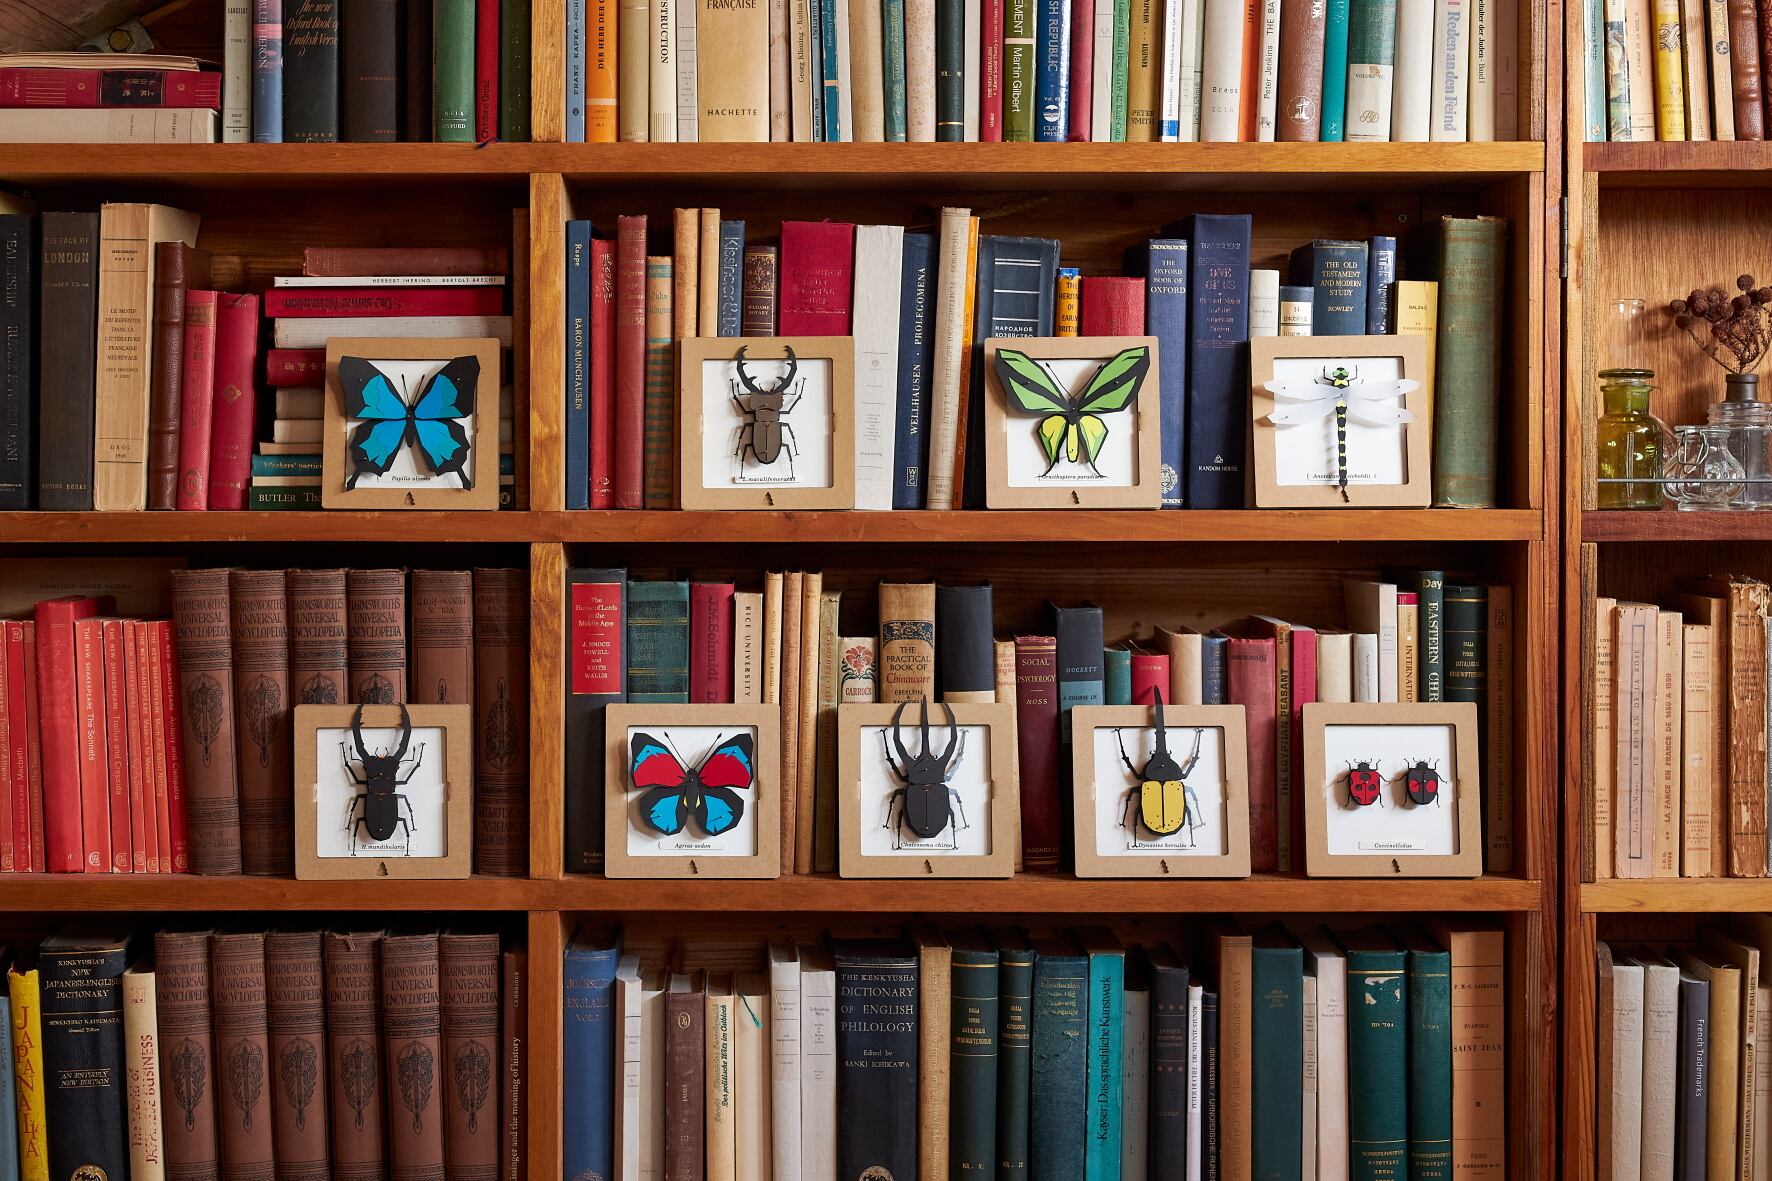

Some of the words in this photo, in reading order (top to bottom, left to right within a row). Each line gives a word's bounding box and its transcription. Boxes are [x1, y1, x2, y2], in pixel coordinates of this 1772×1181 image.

[706, 0, 757, 12] FRANÇAISE
[287, 17, 311, 31] Oxford
[312, 18, 330, 29] Book
[1266, 18, 1274, 35] THE
[1447, 11, 1461, 51] Reden
[1478, 24, 1486, 36] der
[597, 26, 605, 49] HERR
[1048, 18, 1059, 72] REPUBLIC
[258, 29, 268, 68] HERON
[797, 32, 805, 60] Klinzing
[1478, 37, 1486, 59] Juden
[1012, 47, 1023, 79] Martin
[1265, 45, 1273, 76] Jenkins
[1478, 63, 1486, 80] Band
[1263, 78, 1272, 99] Peter
[1445, 71, 1459, 94] den
[1012, 80, 1022, 113] Gilbert
[707, 108, 757, 116] HACHETTE
[1132, 109, 1155, 117] PETER
[1444, 96, 1458, 131] Feind
[1114, 104, 1123, 140] Klett-Cotta
[1131, 117, 1155, 125] SMITH
[44, 252, 89, 264] LONDON
[573, 243, 582, 267] Raspe
[723, 237, 740, 301] Kissinger
[1324, 261, 1340, 269] THE
[1343, 261, 1358, 269] OLD
[1322, 270, 1360, 278] TESTAMENT
[1150, 286, 1186, 294] OXFORD
[1320, 279, 1335, 287] AND
[1335, 279, 1362, 287] MODERN
[914, 267, 926, 345] PROLEGOMENA
[575, 317, 583, 348] BARON
[575, 349, 583, 410] MUNCHAUSEN
[910, 364, 921, 435] WELLHAUSEN
[66, 483, 87, 491] BOOKS
[258, 494, 296, 502] BUTLER
[303, 492, 322, 502] The
[1423, 578, 1442, 590] Day
[180, 611, 224, 624] UNIVERSAL
[239, 612, 282, 624] UNIVERSAL
[296, 612, 340, 623] UNIVERSAL
[354, 612, 396, 624] UNIVERSAL
[1428, 601, 1439, 664] EASTERN
[899, 646, 916, 654] THE
[886, 655, 930, 663] PRACTICAL
[1022, 657, 1051, 666] SOCIAL
[890, 663, 914, 671] BOOK
[916, 663, 928, 671] OF
[85, 661, 93, 710] SHAKESPEARE
[886, 671, 930, 685] Chinaware
[1017, 674, 1056, 683] PSYCHOLOGY
[110, 662, 118, 710] SHAKESPEARE
[166, 662, 174, 711] SHAKESPEARE
[1280, 668, 1289, 716] PEASANT
[87, 713, 95, 728] The
[1665, 721, 1672, 732] DE
[112, 715, 121, 742] Troilus
[143, 718, 151, 745] Measure
[169, 716, 178, 744] Antony
[87, 729, 96, 761] Sonnets
[1279, 721, 1288, 774] EGYPTIAN
[1664, 735, 1672, 767] FRANCE
[16, 747, 25, 781] Macbeth
[144, 757, 152, 784] Measure
[114, 760, 123, 795] Cressida
[171, 762, 181, 800] Cleopatra
[1664, 770, 1671, 780] EN
[1279, 776, 1288, 796] THE
[1664, 811, 1671, 823] LA
[361, 843, 406, 851] H.mandibularis
[57, 958, 105, 966] KENKYUSHA'S
[71, 968, 91, 977] NEW
[841, 974, 858, 982] THE
[861, 973, 915, 982] KENKYUSHA
[45, 977, 122, 989] JAPANESE-ENGLISH
[163, 976, 206, 989] UNIVERSAL
[222, 976, 265, 989] UNIVERSAL
[275, 975, 319, 988] UNIVERSAL
[391, 978, 434, 991] UNIVERSAL
[450, 978, 492, 990] UNIVERSAL
[56, 989, 109, 999] DICTIONARY
[841, 986, 914, 997] DICTIONARY
[1098, 975, 1112, 1027] Kunstwerk
[840, 1004, 855, 1015] OF
[863, 1004, 914, 1015] ENGLISH
[841, 1022, 914, 1033] PHILOLOGY
[1696, 1019, 1705, 1047] French
[509, 1037, 521, 1070] history
[885, 1049, 893, 1058] by
[1098, 1029, 1111, 1082] sprachliche
[845, 1060, 868, 1068] SANKI
[872, 1060, 911, 1068] ICHIKAWA
[61, 1071, 73, 1079] AN
[75, 1070, 108, 1079] ENTIRELY
[511, 1071, 519, 1085] of
[1695, 1049, 1704, 1097] Trademarks
[61, 1078, 77, 1087] NEW
[80, 1078, 109, 1086] EDITION
[511, 1086, 521, 1115] meaning
[1097, 1083, 1109, 1103] Das
[720, 1095, 729, 1108] Der
[511, 1115, 519, 1131] the
[1096, 1102, 1109, 1140] Kayser:
[1208, 1098, 1216, 1154] URNORDISCHE
[510, 1132, 519, 1147] and
